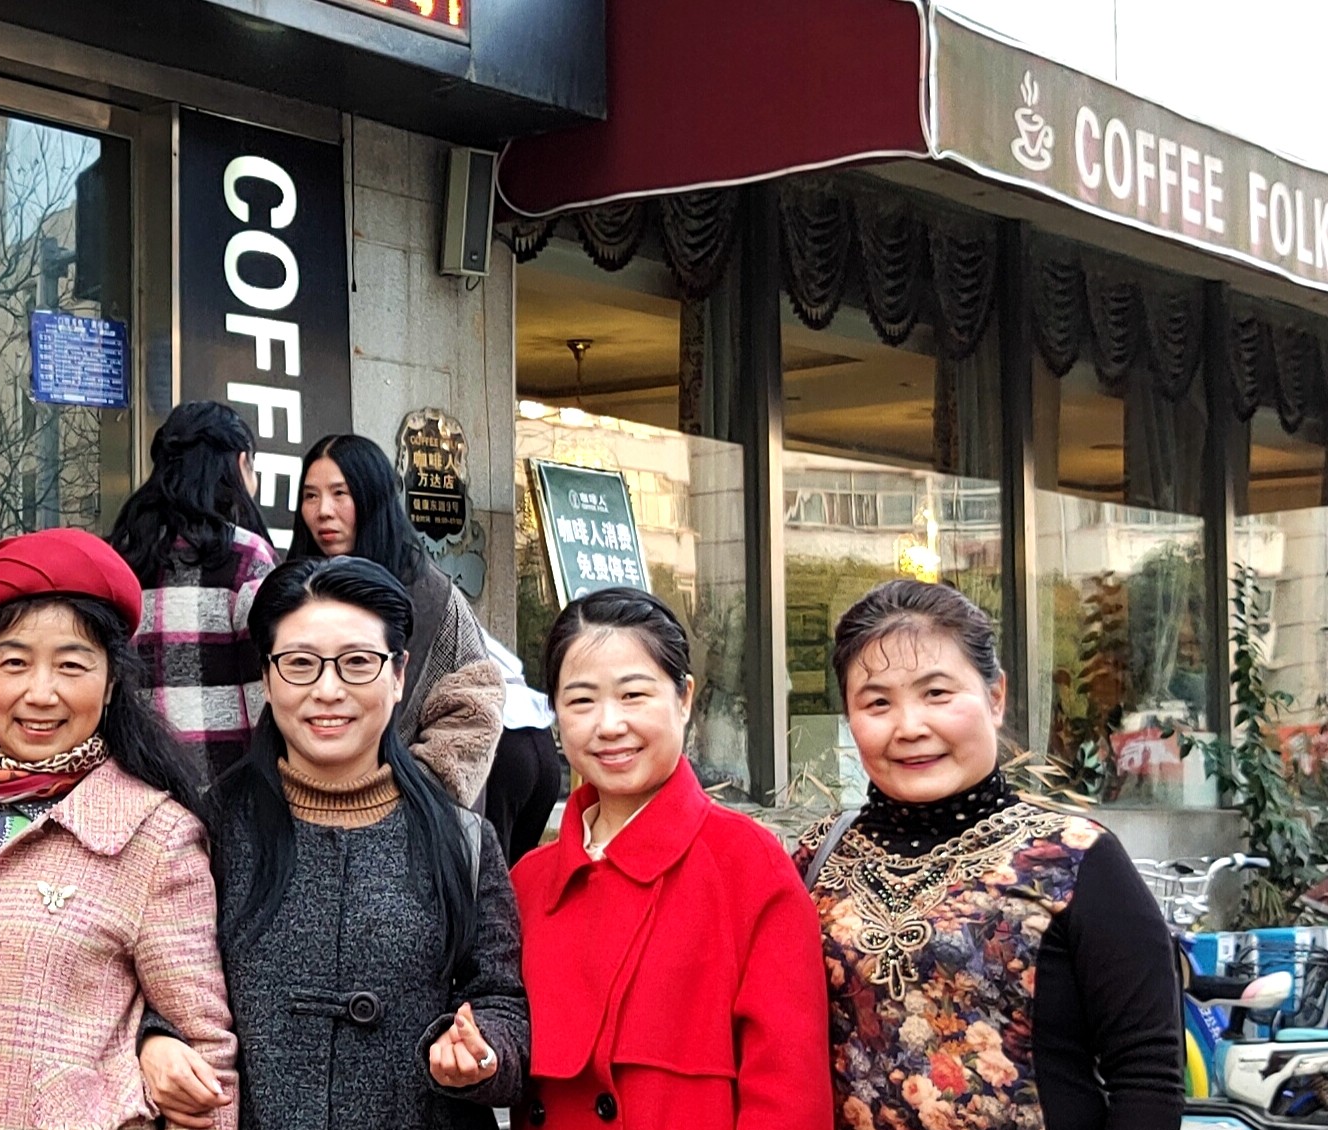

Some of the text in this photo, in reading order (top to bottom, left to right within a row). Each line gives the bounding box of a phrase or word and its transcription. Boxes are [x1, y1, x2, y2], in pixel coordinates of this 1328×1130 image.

[1074, 105, 1225, 234] COFFEE
[224, 155, 303, 551] COFFE
[413, 450, 458, 473] 咖啡人
[417, 472, 455, 490] 万达店
[557, 515, 634, 552] 咖啡人消费
[576, 551, 640, 585] 免费停车
